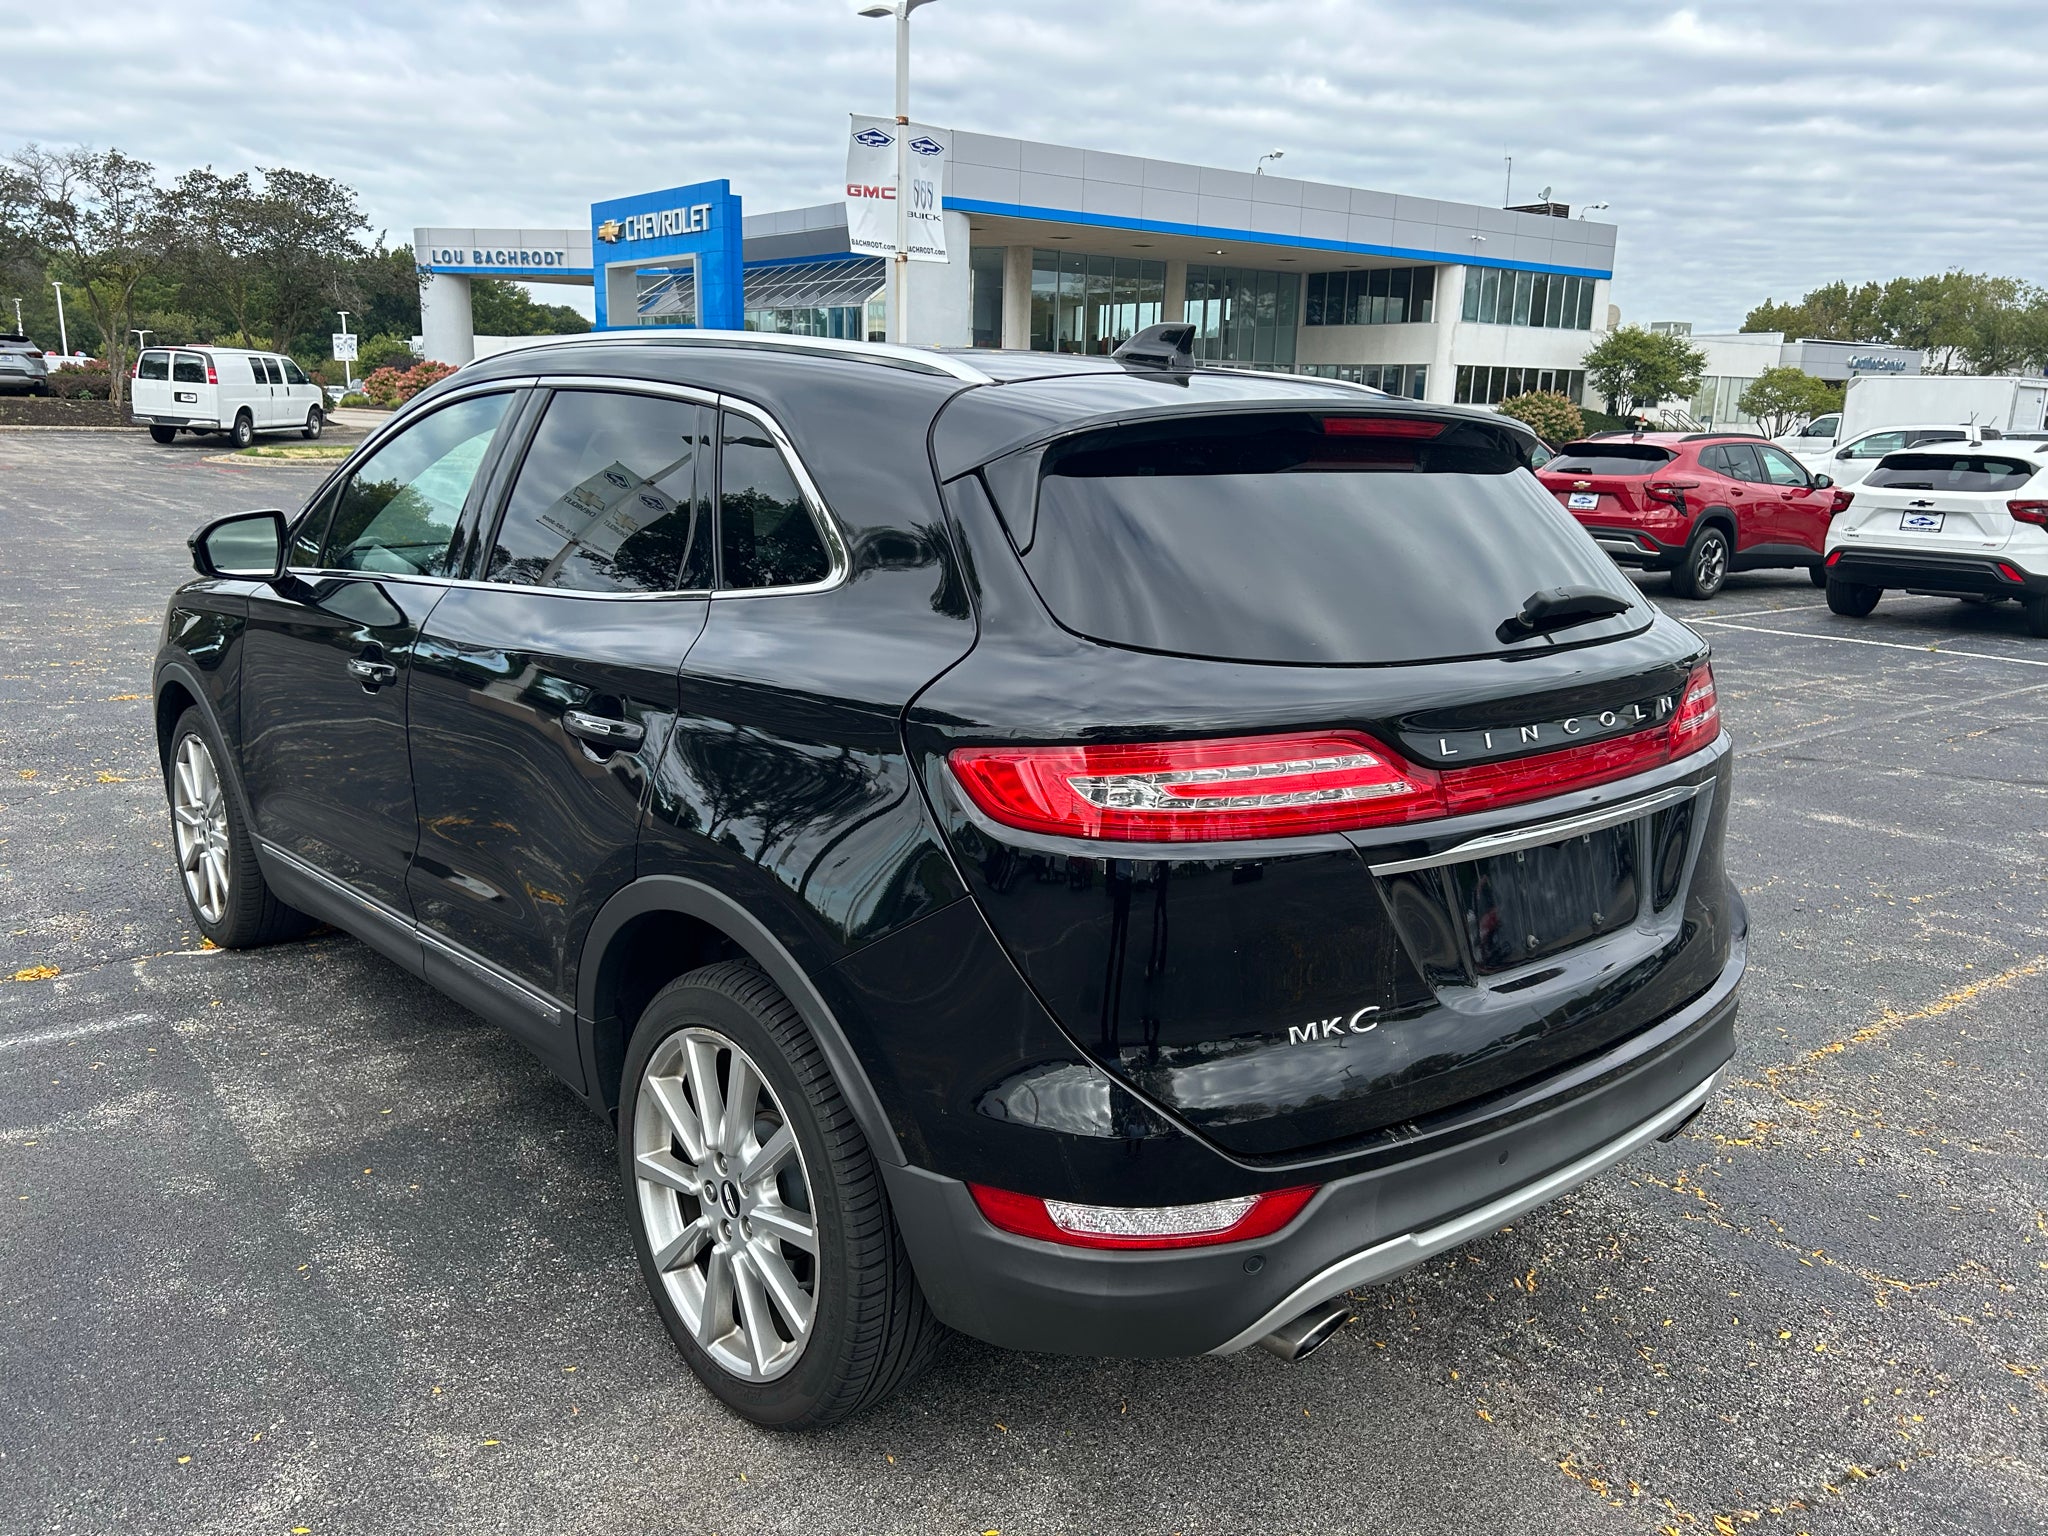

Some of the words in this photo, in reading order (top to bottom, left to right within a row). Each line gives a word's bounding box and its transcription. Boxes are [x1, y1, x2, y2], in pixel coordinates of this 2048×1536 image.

[847, 184, 896, 199] GMC
[625, 203, 712, 241] CHEVROLET
[907, 211, 942, 221] BUICK
[851, 239, 897, 250] BACHRODT.com
[432, 250, 464, 264] LOU
[473, 251, 565, 266] BACHRODT
[1439, 696, 1673, 756] LINCOLN
[1288, 1005, 1381, 1046] MKC
